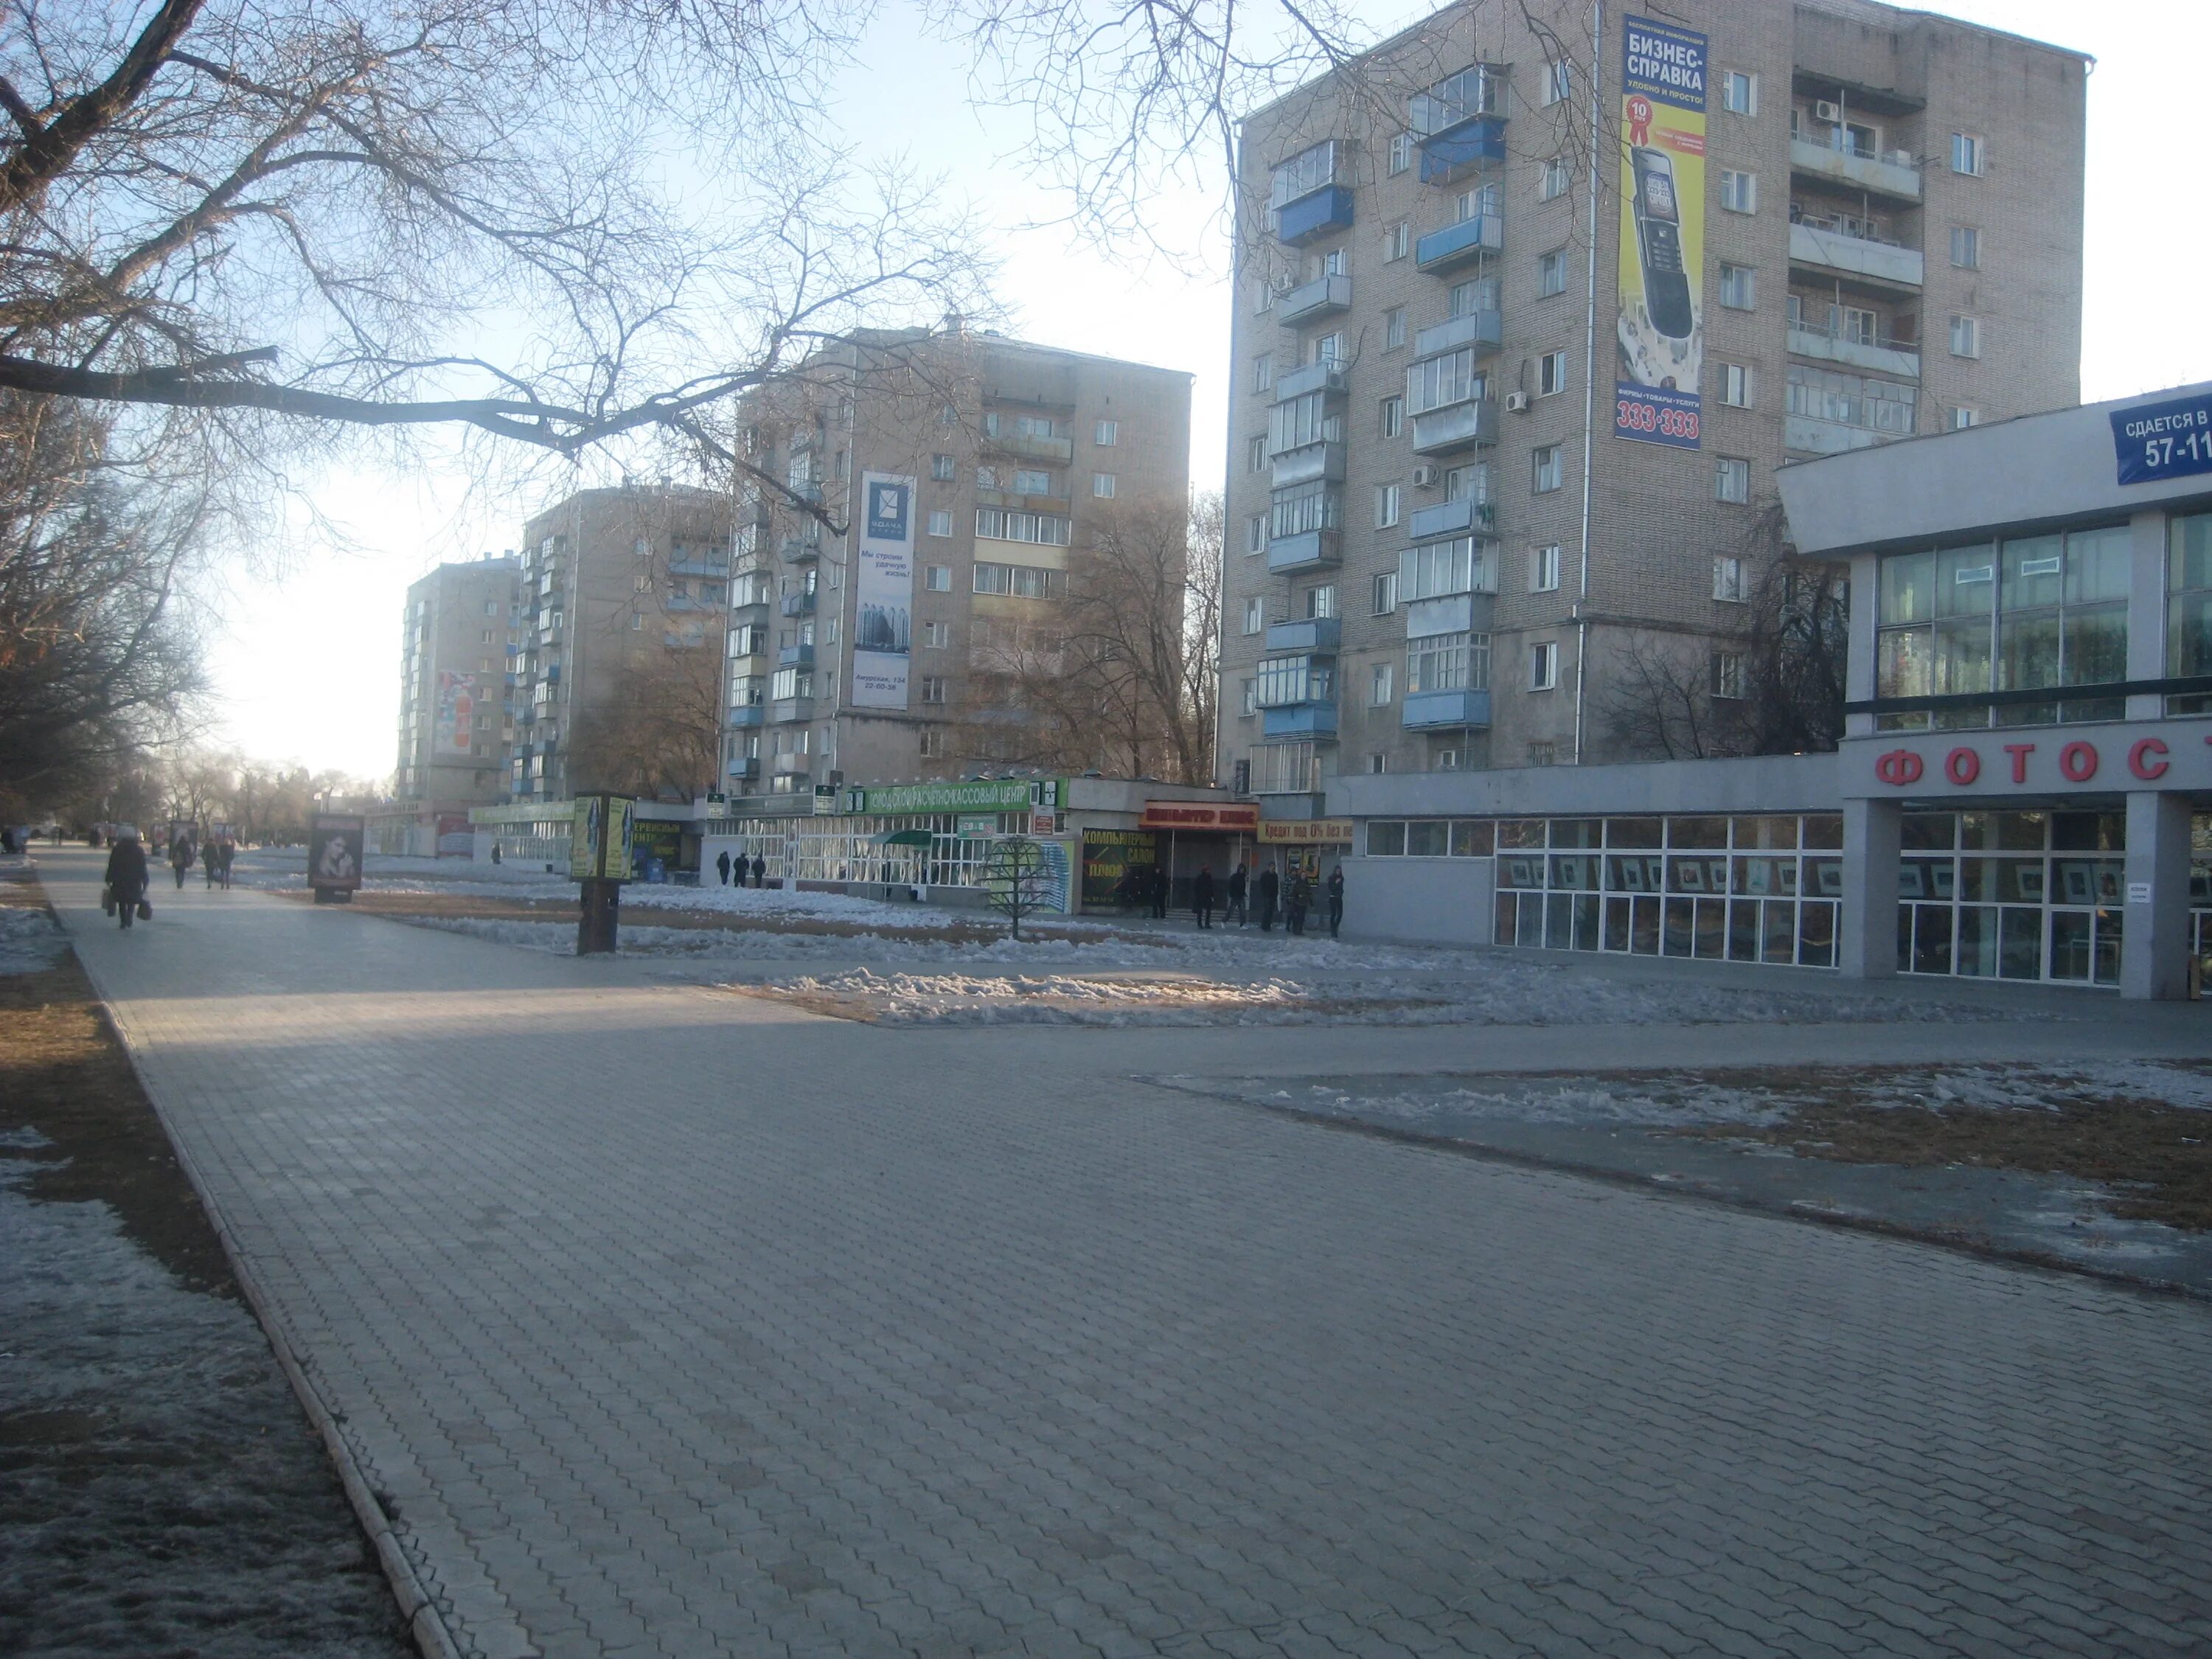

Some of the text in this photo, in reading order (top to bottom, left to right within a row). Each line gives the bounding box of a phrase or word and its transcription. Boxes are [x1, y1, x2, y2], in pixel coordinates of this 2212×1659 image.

[1629, 33, 1703, 69] БИЗНЕС-
[1627, 55, 1703, 91] СПРАВКА
[1627, 80, 1660, 94] УДОБНО
[1669, 90, 1703, 105] ПРОСТО!
[1632, 102, 1647, 117] 10
[1618, 388, 1700, 408] ФИРМЫ ТОВАРЫ УСЛУГИ
[2126, 410, 2208, 438] СДАЕТСЯ В
[871, 520, 902, 529] УДАЧА
[875, 552, 902, 560] строим
[1000, 785, 1026, 806] ЦЕНТР
[1083, 830, 1156, 847] КОМПЬЮТЕРНЫЙ
[1265, 824, 1291, 839] Кредит
[1326, 824, 1340, 838] без
[1127, 847, 1155, 863] САЛОН
[1090, 863, 1124, 878] ПЛЮС
